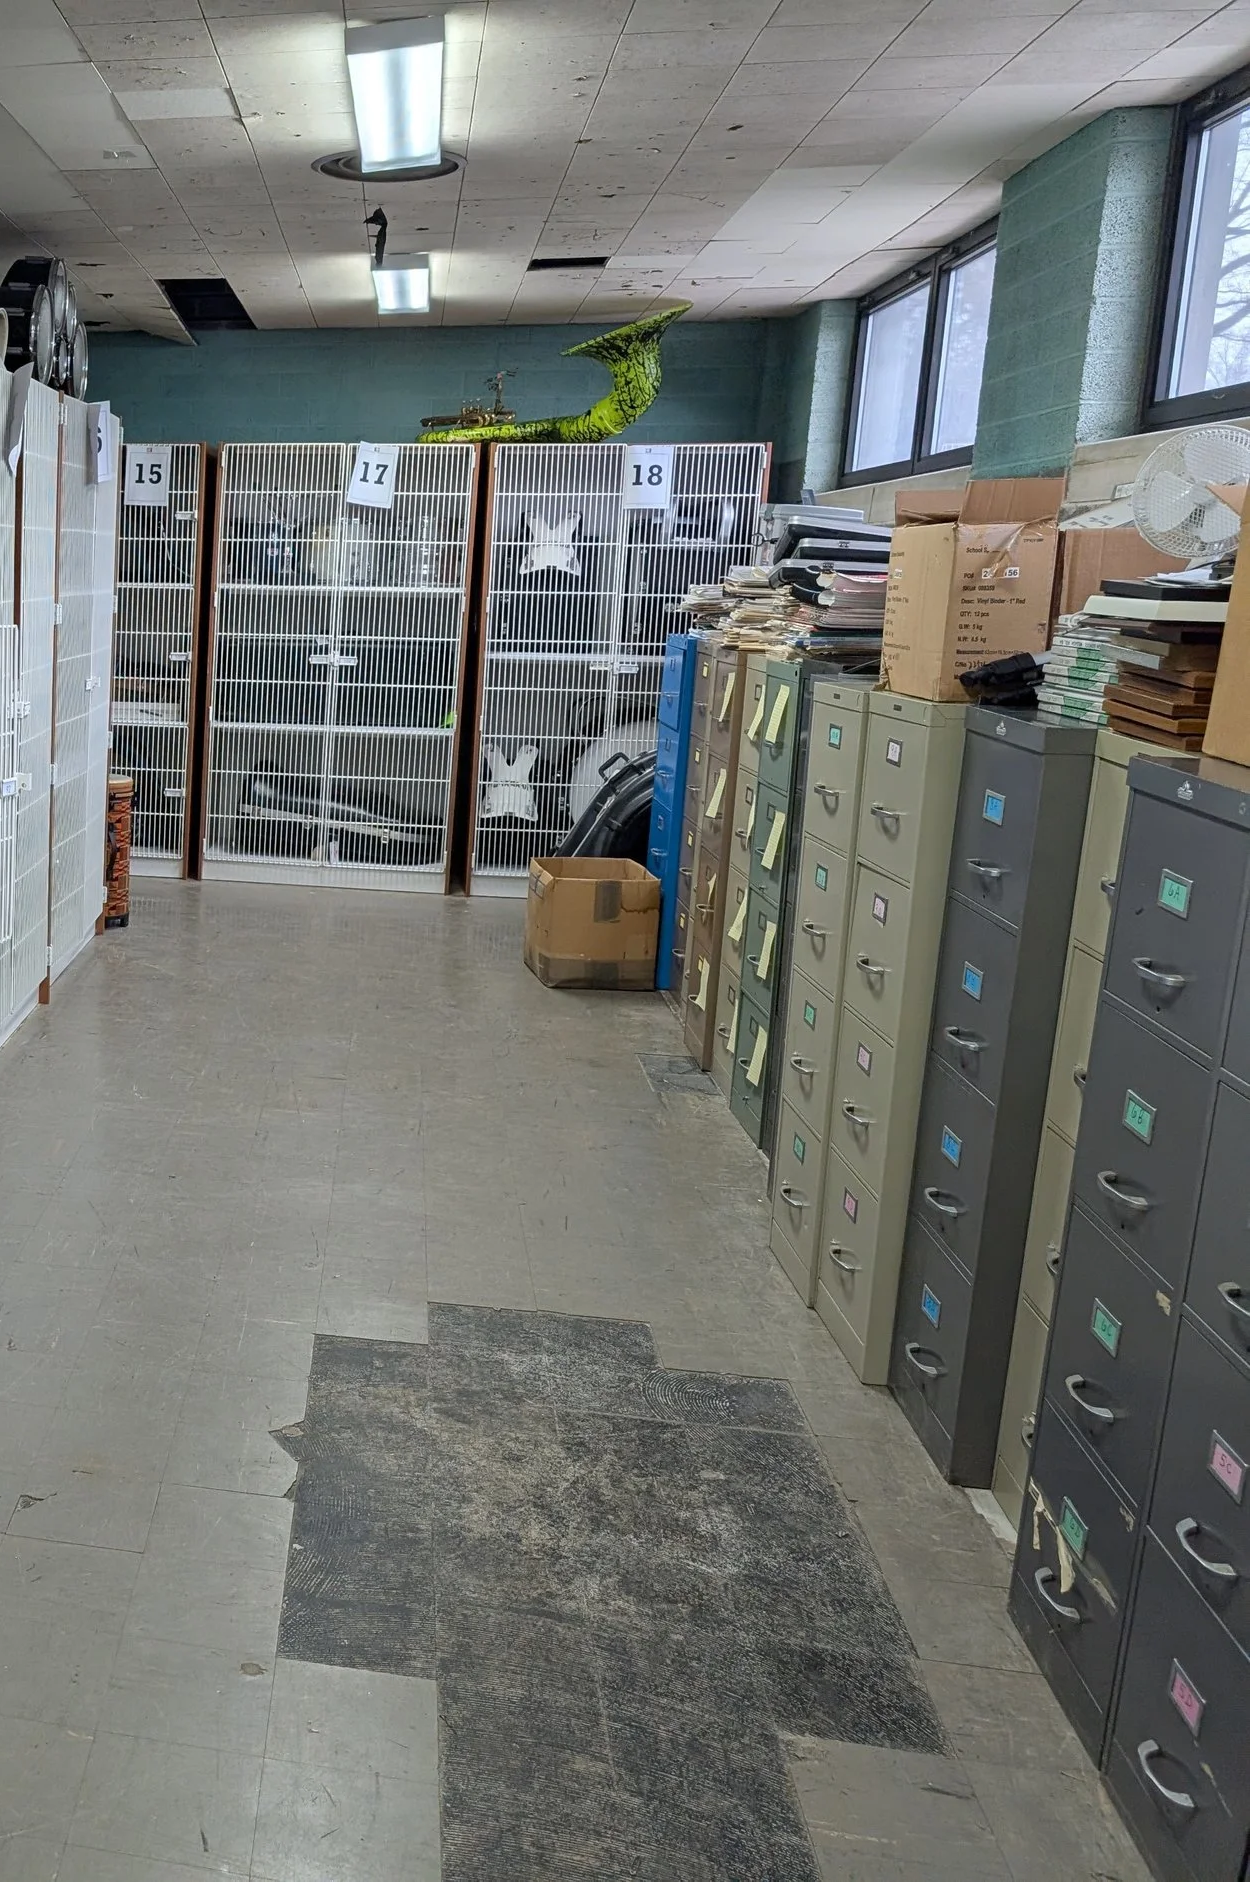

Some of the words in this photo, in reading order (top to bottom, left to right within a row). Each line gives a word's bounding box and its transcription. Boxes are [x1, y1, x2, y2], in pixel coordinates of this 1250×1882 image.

[134, 463, 162, 485] 15
[359, 461, 389, 485] 17
[632, 464, 663, 486] 18
[977, 597, 989, 605] Vinyl
[990, 597, 1006, 605] Binder
